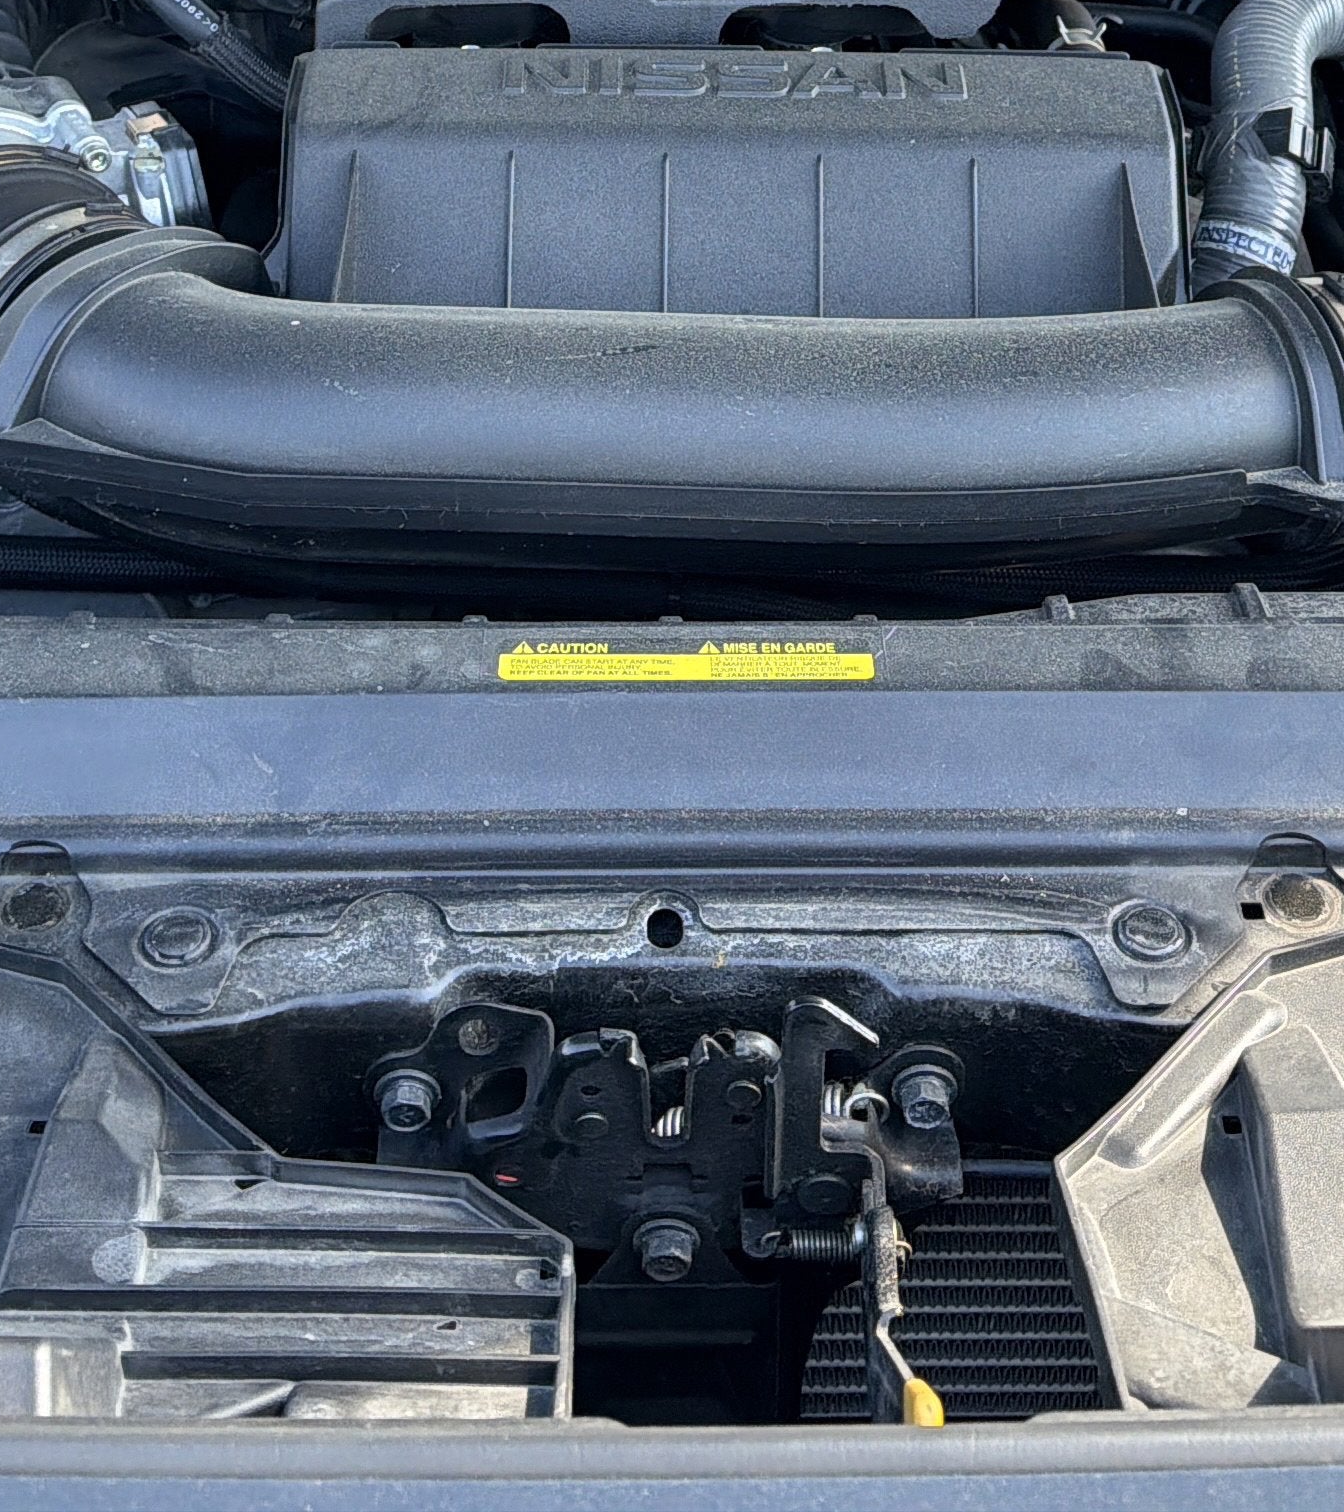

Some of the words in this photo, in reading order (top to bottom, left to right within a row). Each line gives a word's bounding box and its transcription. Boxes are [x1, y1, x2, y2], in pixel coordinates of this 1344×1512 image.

[502, 57, 969, 100] NISSAN
[536, 642, 609, 654] CAUTION
[723, 642, 758, 654] MISE
[762, 642, 781, 654] EN
[784, 642, 836, 654] GARDE
